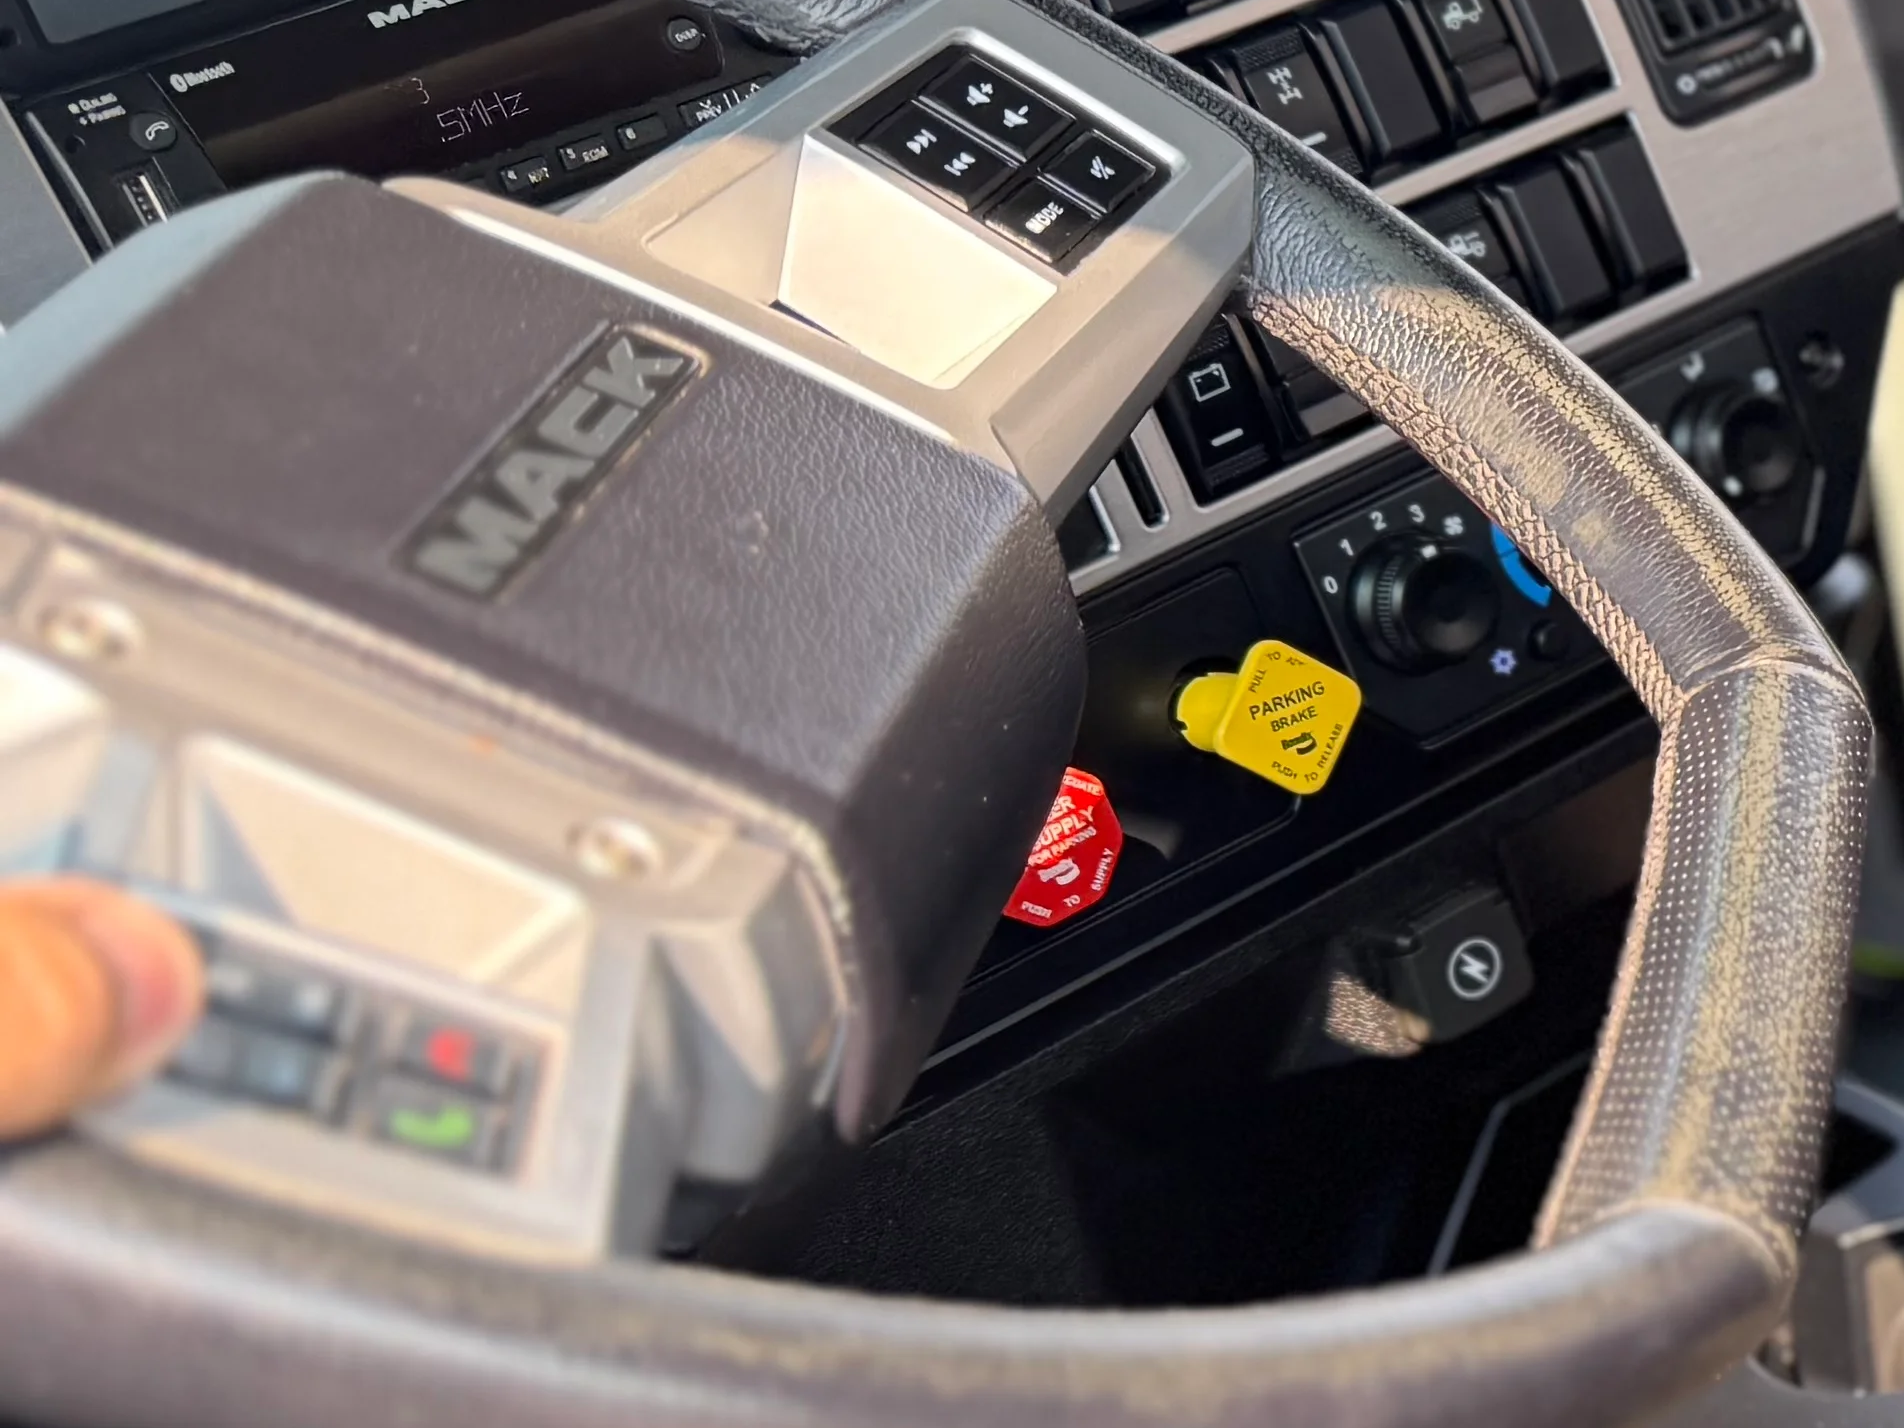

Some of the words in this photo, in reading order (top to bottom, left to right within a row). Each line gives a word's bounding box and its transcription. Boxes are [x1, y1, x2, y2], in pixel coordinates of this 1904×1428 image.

[1025, 202, 1064, 234] MODE
[416, 336, 684, 594] MACK
[1370, 511, 1387, 530] 2
[1408, 504, 1425, 522] 3
[1339, 539, 1353, 556] 1
[1324, 576, 1338, 594] 0
[1248, 669, 1266, 693] PULL
[1266, 651, 1281, 661] TO
[1248, 681, 1325, 720] PARKING
[1270, 706, 1318, 732] BRAKE
[1304, 772, 1318, 783] TO
[1063, 895, 1080, 907] TO
